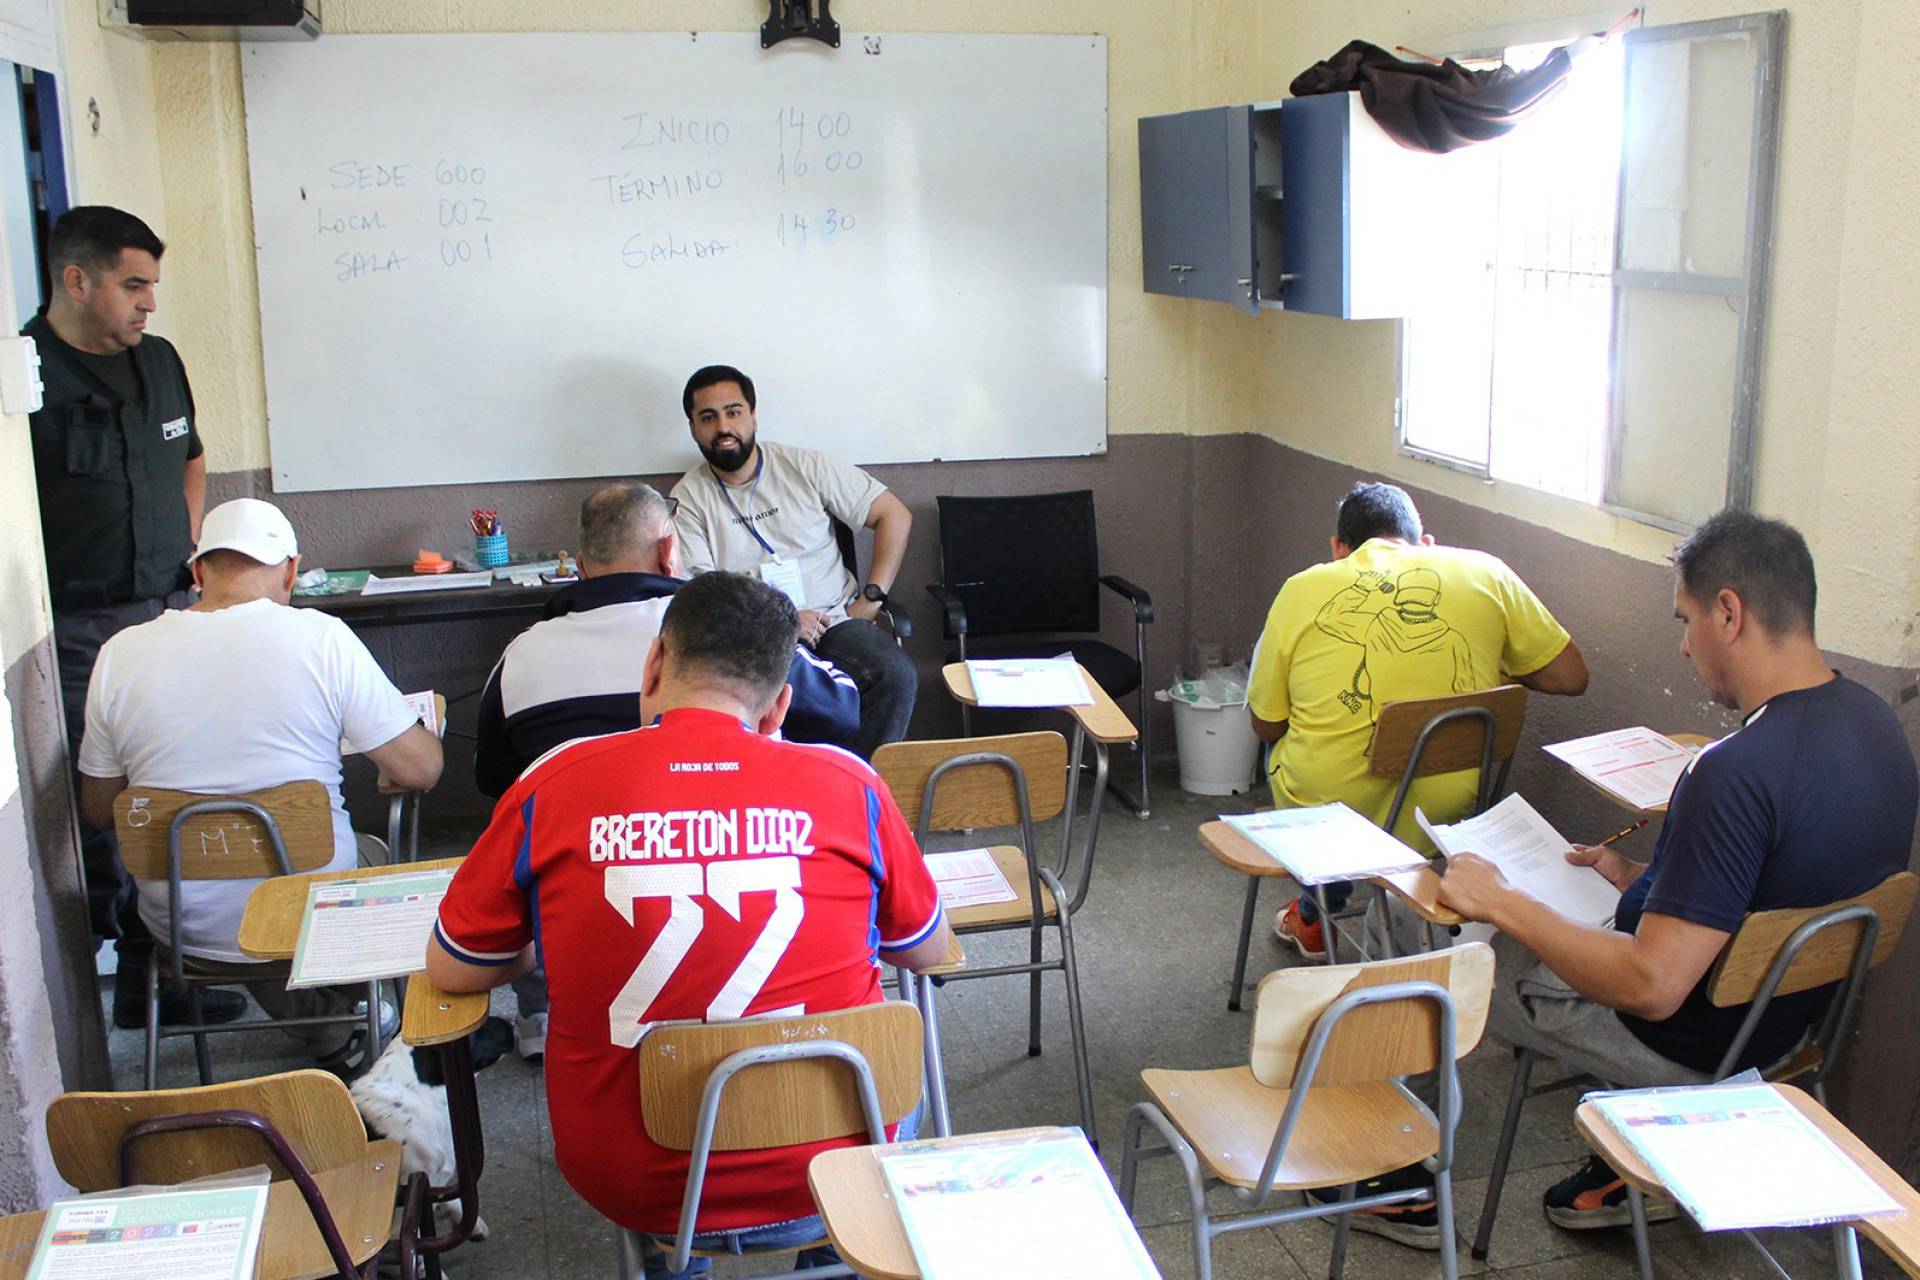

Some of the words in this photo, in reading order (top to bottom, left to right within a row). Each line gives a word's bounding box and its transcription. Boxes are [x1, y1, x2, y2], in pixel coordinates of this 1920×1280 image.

[328, 159, 413, 190] SEDE
[434, 157, 487, 186] 600
[317, 206, 388, 235] LOCAL
[438, 197, 494, 228] 002
[333, 250, 410, 282] SALA
[439, 232, 494, 267] 001
[1337, 689, 1362, 715] KING
[669, 761, 680, 772] LA
[681, 761, 702, 772] ROJA
[702, 761, 714, 772] DE
[714, 761, 740, 772] TODOS
[589, 809, 738, 862] BRERETON
[745, 807, 815, 856] DIAZ
